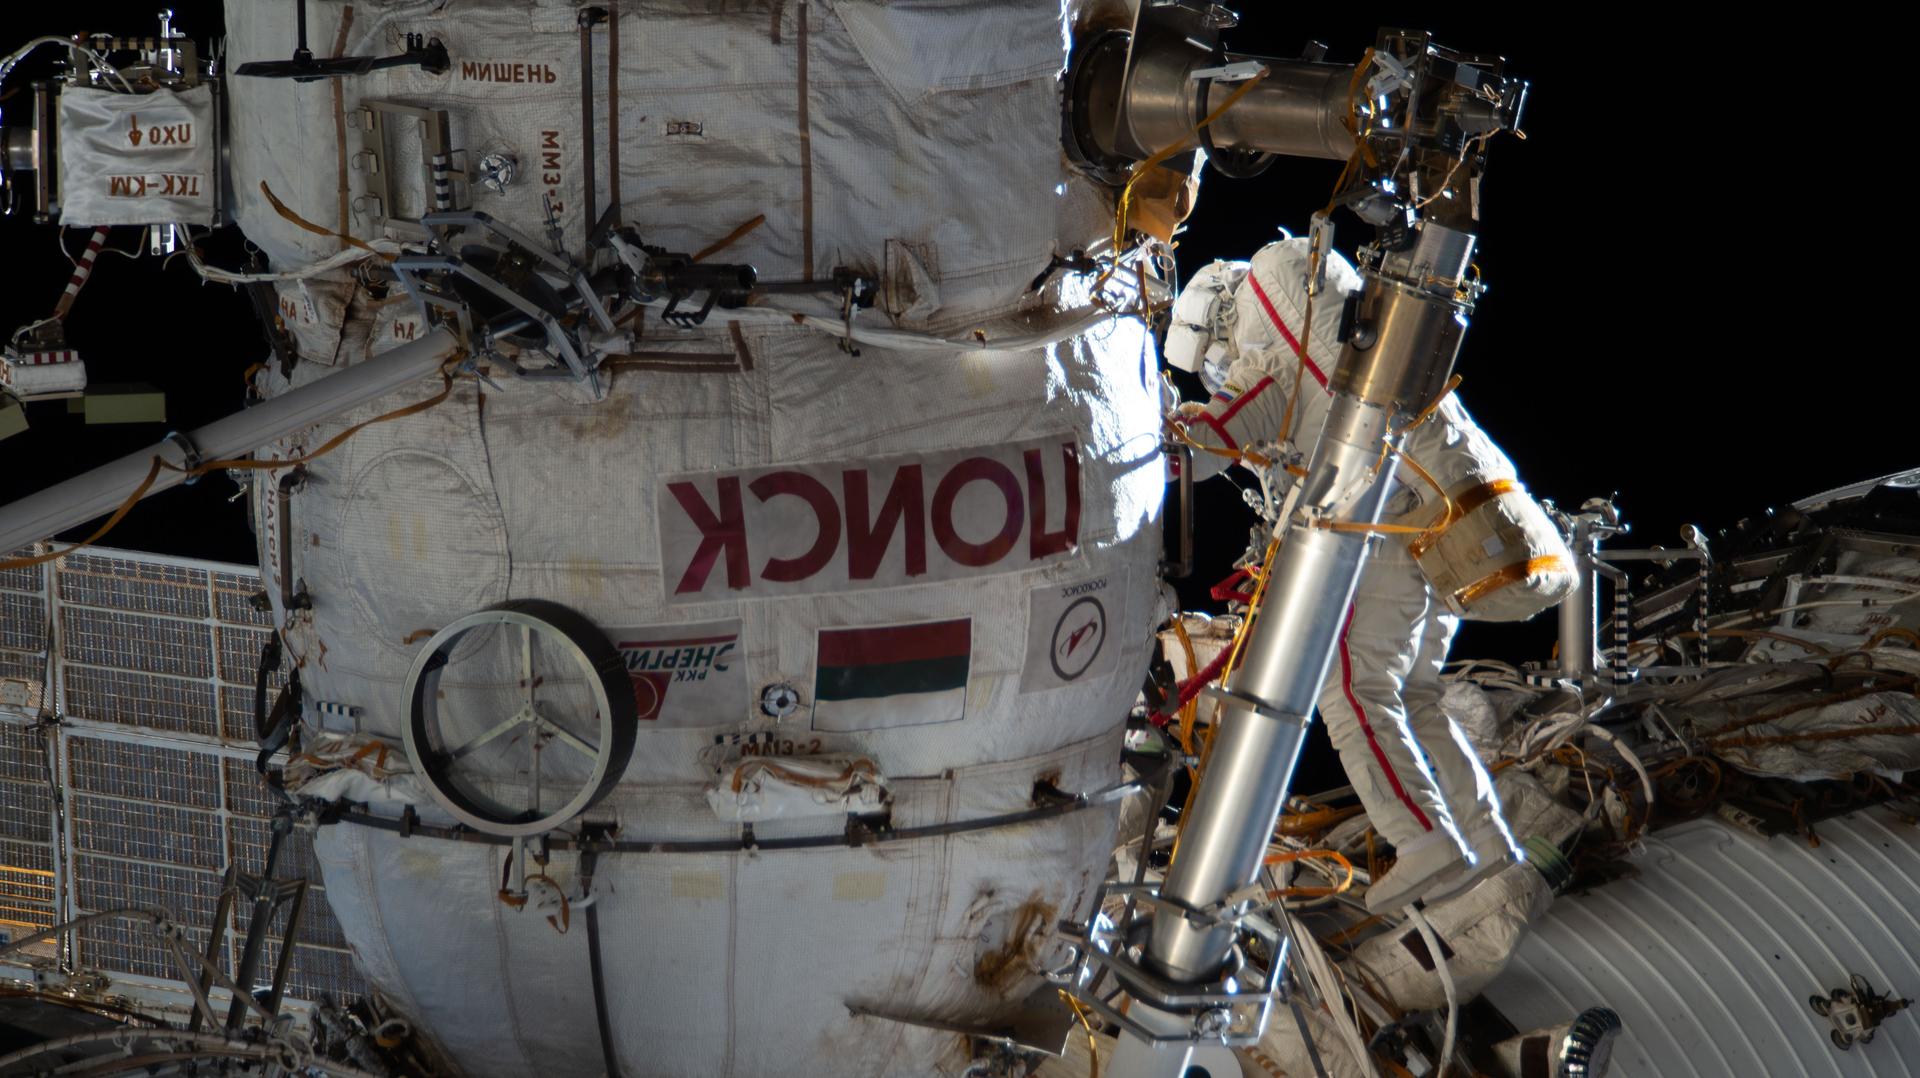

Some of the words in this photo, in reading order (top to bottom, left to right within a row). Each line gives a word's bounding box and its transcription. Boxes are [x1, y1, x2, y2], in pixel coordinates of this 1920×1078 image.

[462, 62, 556, 83] МИШЕНЬ
[111, 174, 200, 197] ТКК-КМ
[267, 490, 277, 567] HATCH
[667, 441, 1081, 593] ПОИСК
[673, 670, 708, 683] РКК
